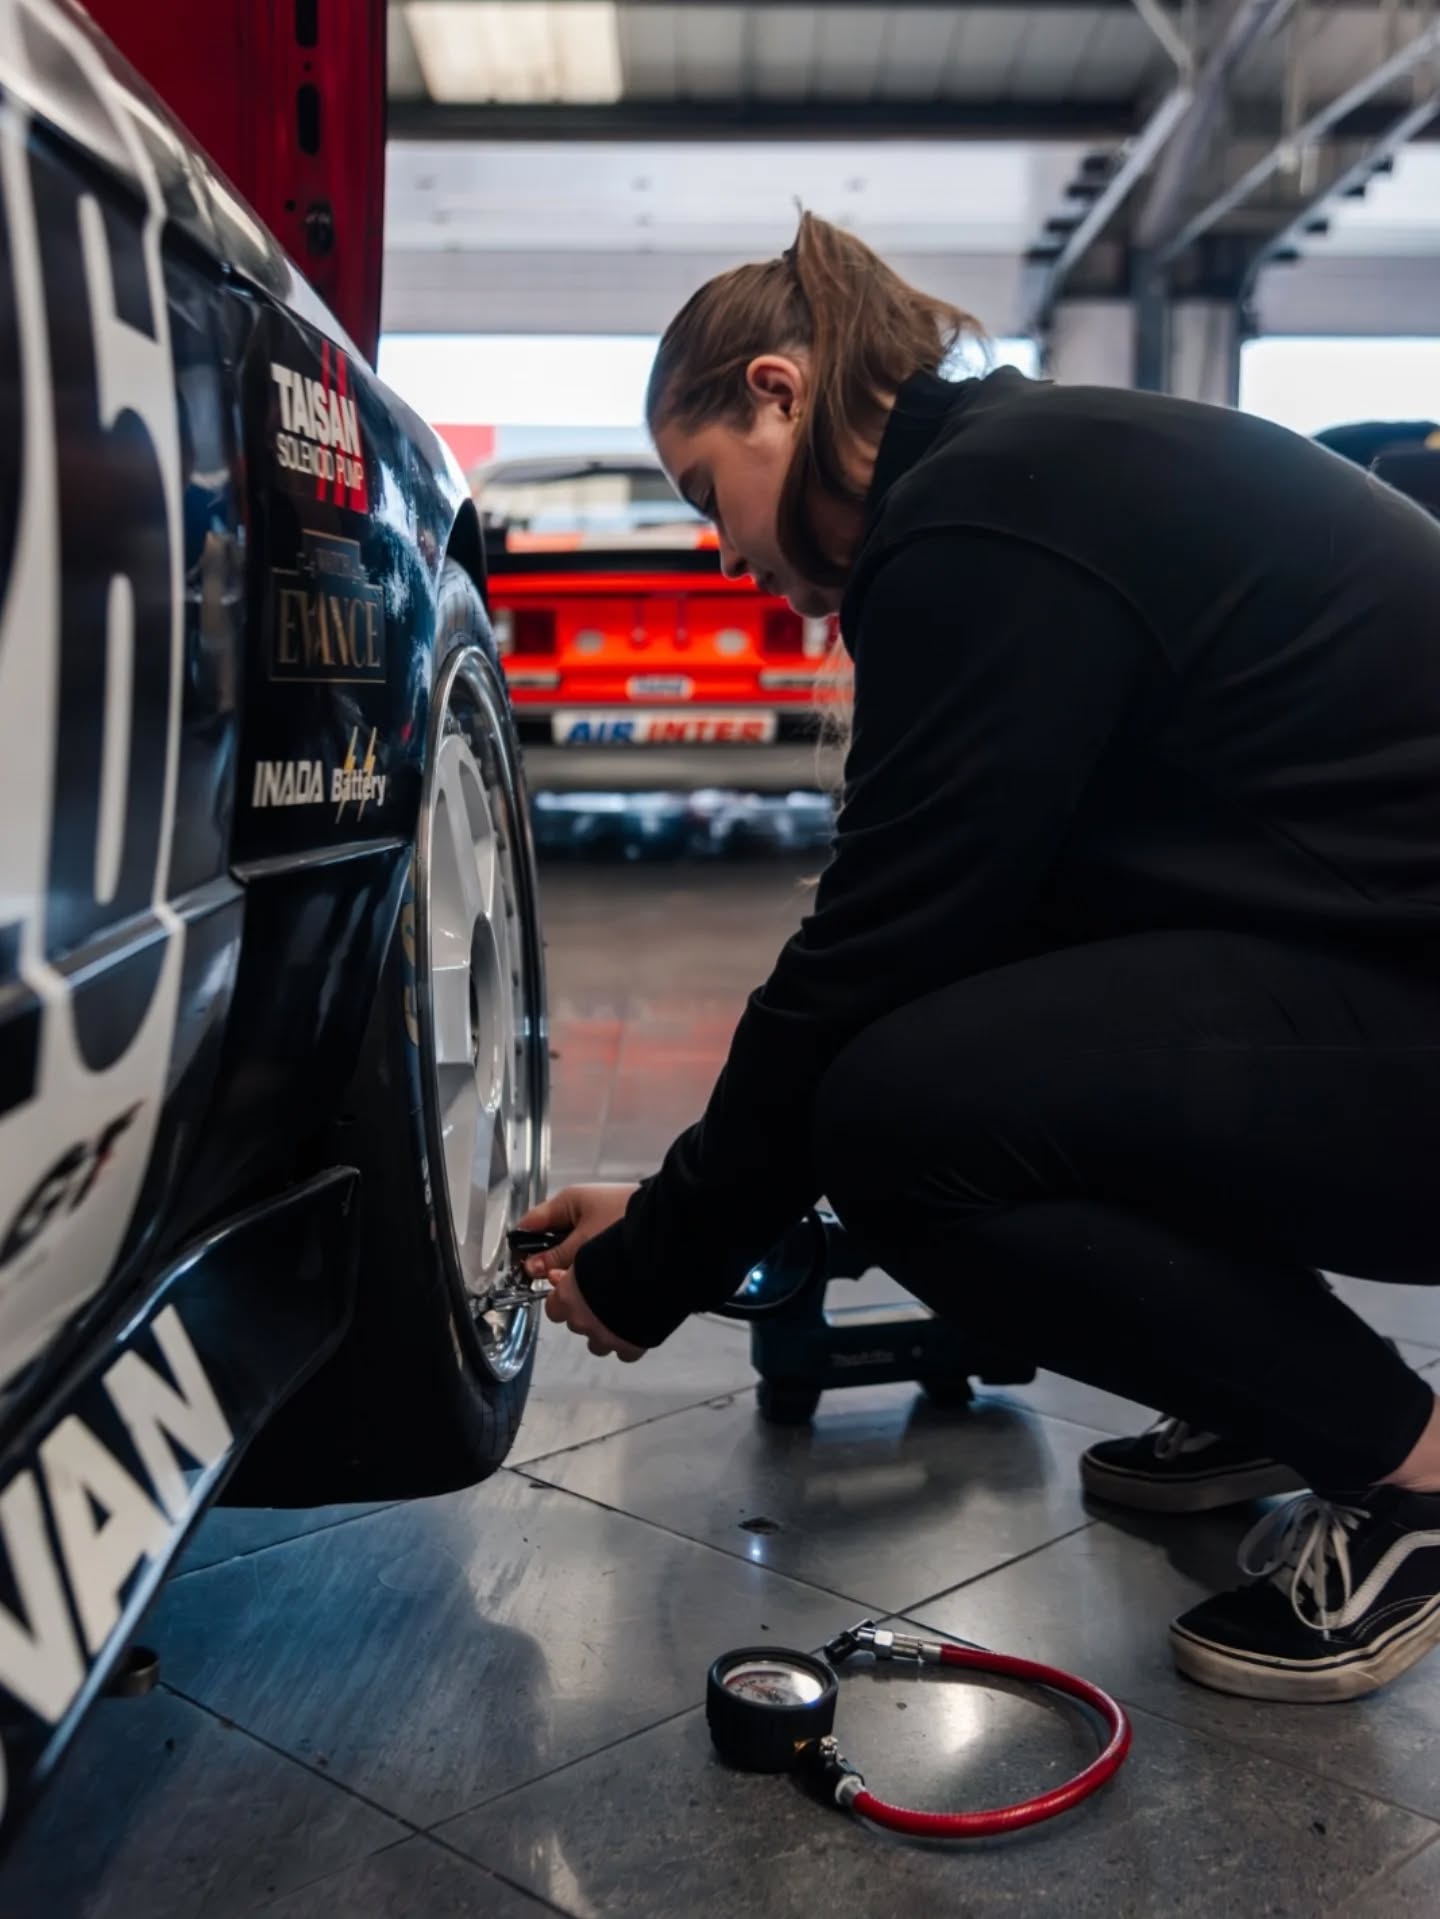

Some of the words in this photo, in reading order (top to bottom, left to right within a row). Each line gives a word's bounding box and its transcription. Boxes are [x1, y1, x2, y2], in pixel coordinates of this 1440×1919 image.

[270, 362, 362, 458] TAISAN
[278, 589, 382, 669] EVANCE
[566, 719, 635, 742] AIR
[647, 719, 765, 742] INTER
[252, 760, 325, 808] INADA
[330, 768, 387, 807] Battery
[0, 1303, 234, 1726] VAN
